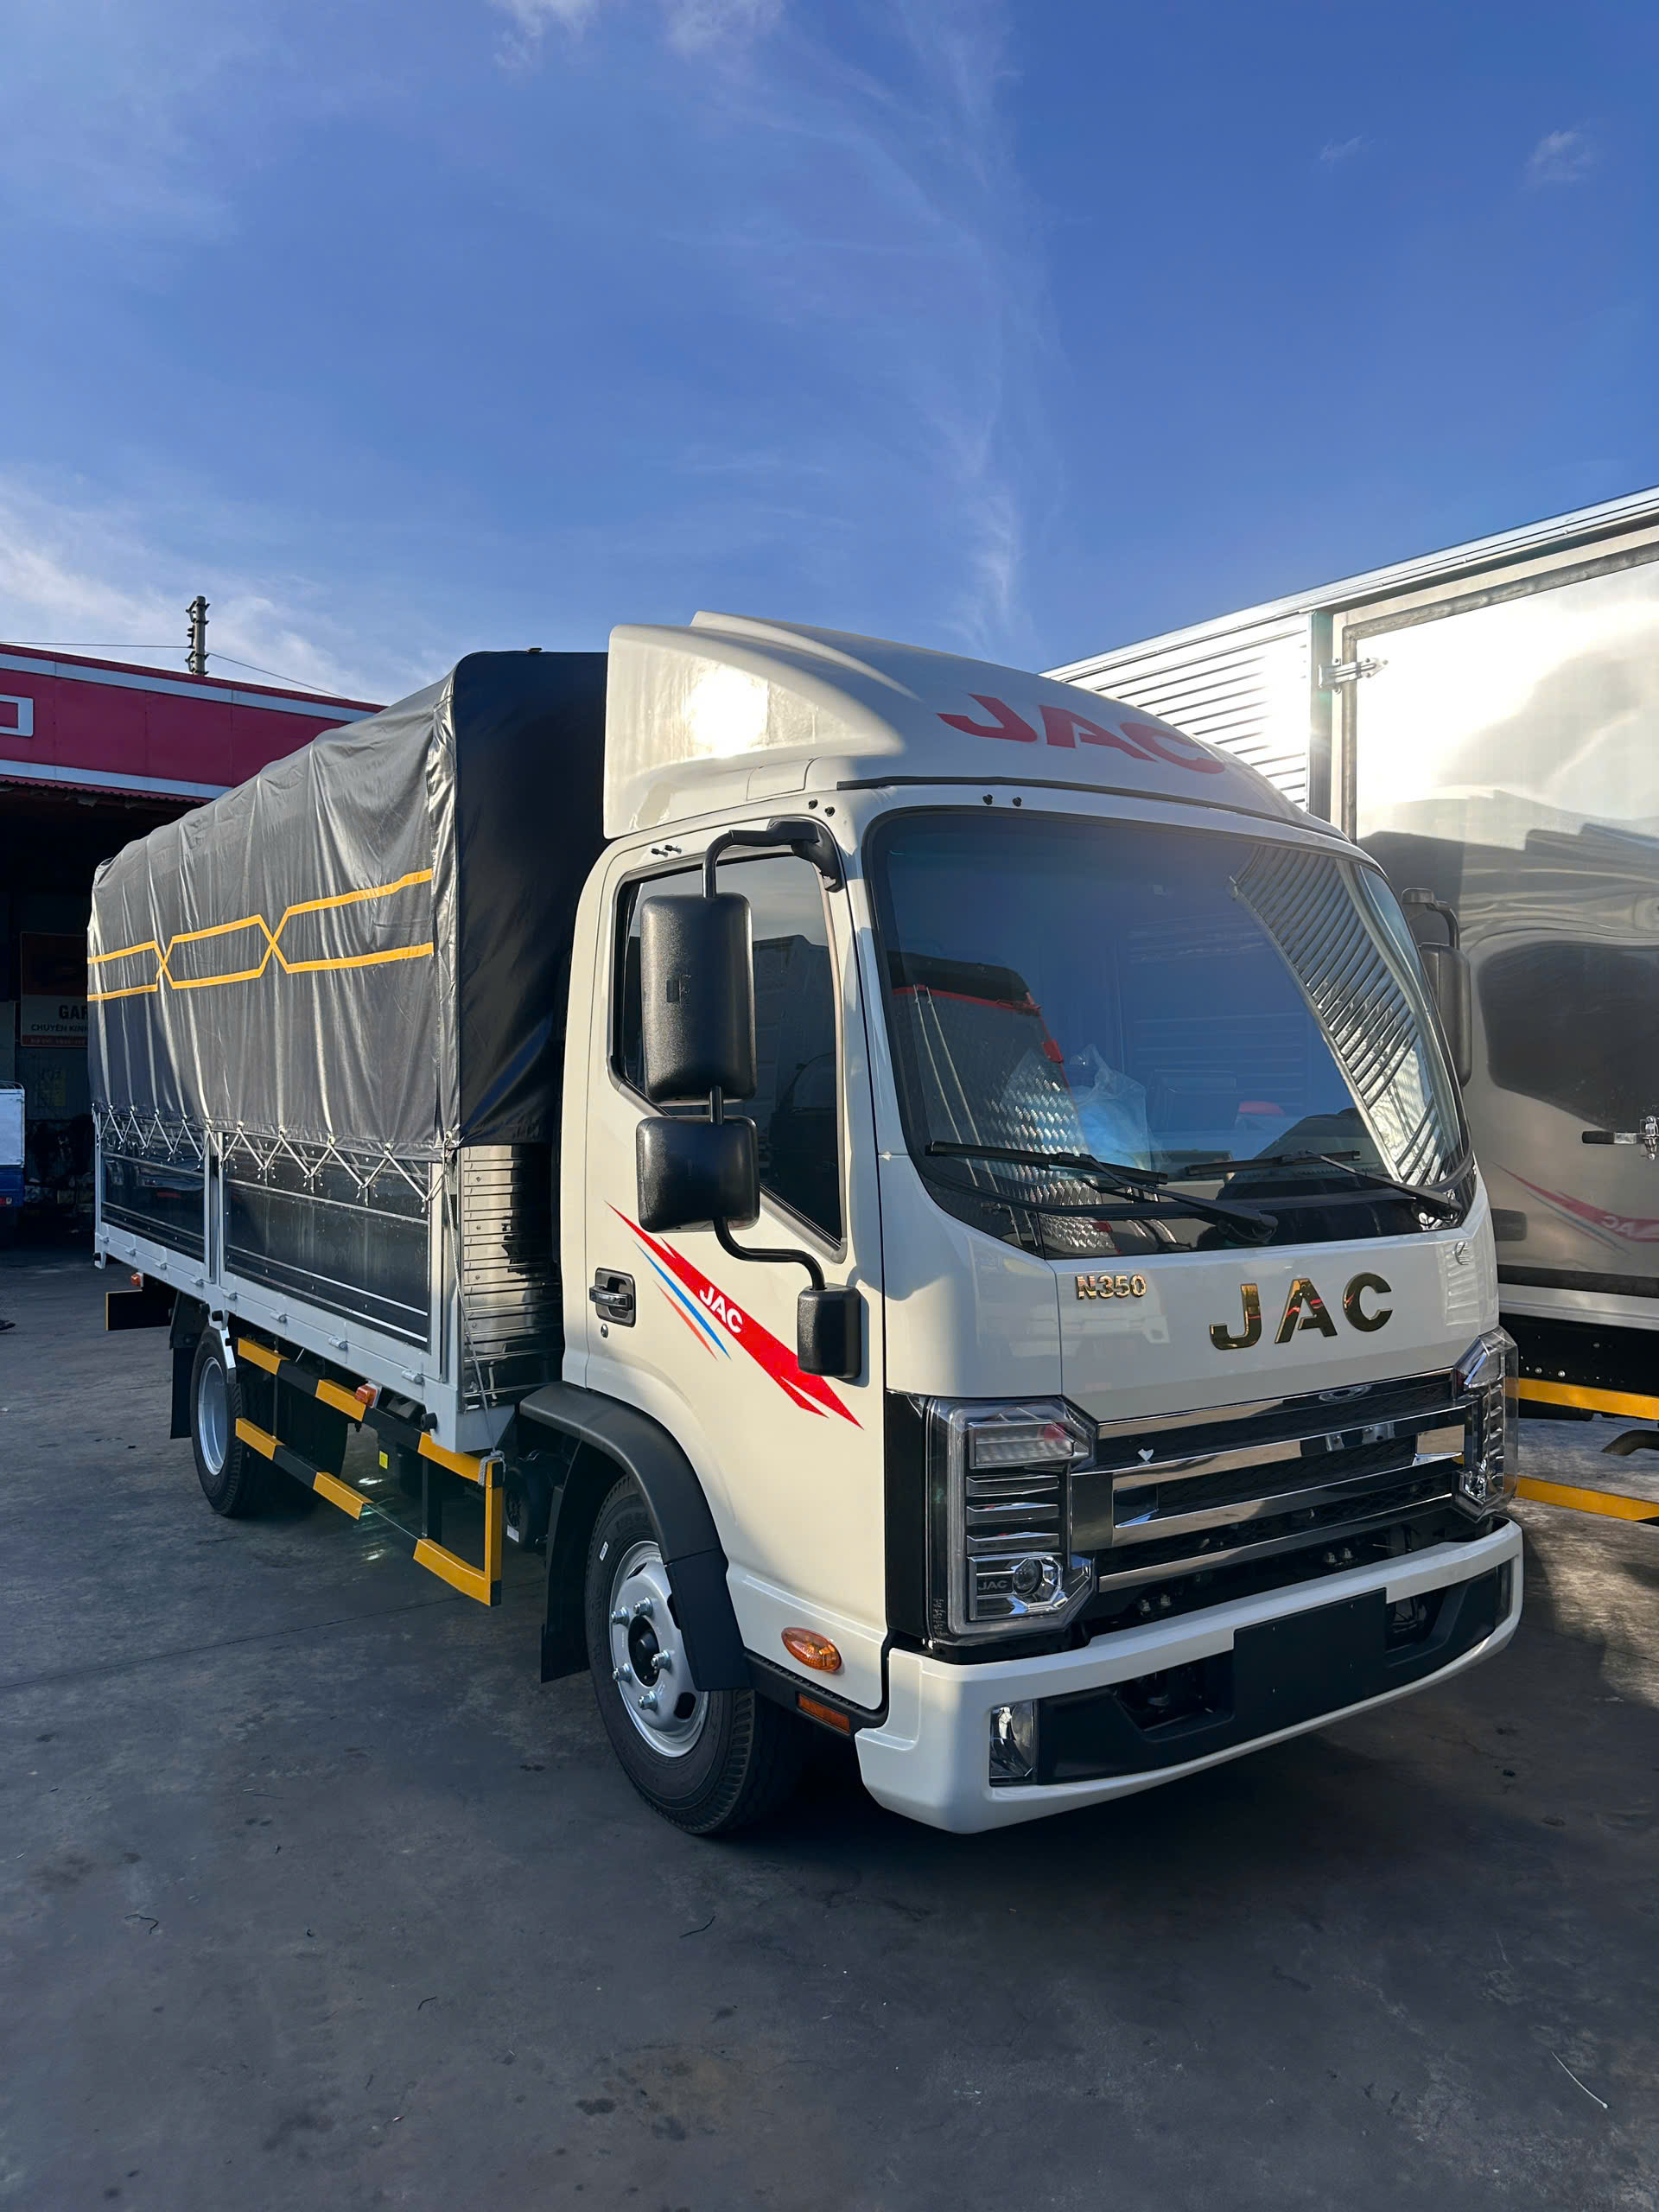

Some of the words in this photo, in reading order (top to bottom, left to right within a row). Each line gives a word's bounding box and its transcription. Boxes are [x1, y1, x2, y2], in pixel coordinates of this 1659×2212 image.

[936, 692, 1225, 774] JAC
[699, 1286, 744, 1333] JAC
[1075, 1274, 1147, 1300] N350
[1210, 1272, 1393, 1351] JAC
[978, 1580, 1007, 1591] JAC
